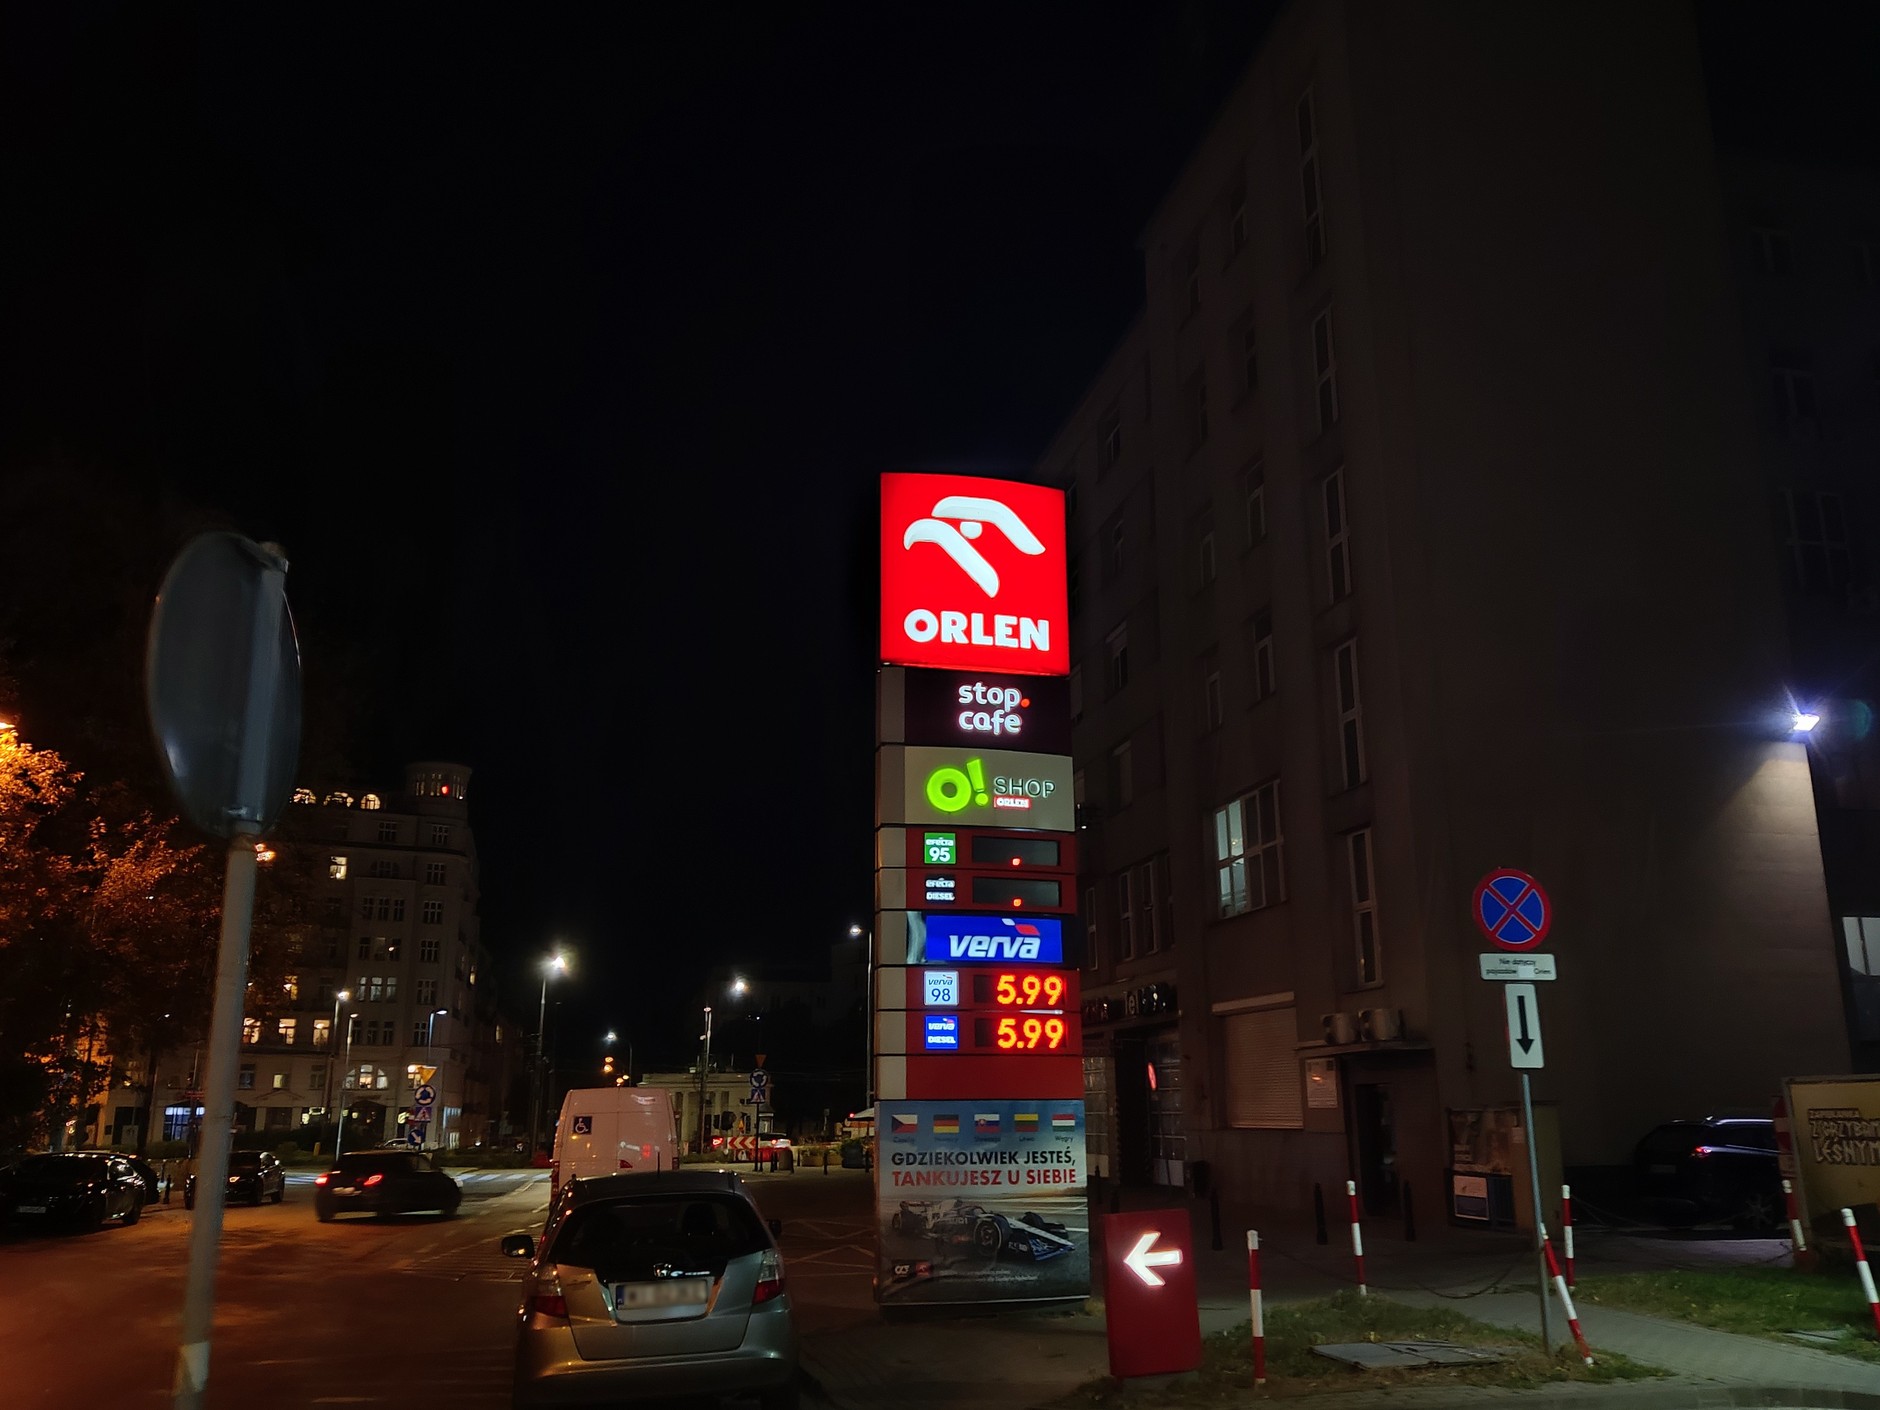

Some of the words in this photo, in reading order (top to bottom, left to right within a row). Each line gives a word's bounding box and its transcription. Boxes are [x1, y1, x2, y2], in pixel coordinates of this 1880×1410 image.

[904, 609, 1050, 651] ORLEN
[958, 710, 1022, 735] cafe
[926, 758, 989, 812] O!
[994, 776, 1055, 798] SHOP
[929, 847, 951, 862] 95
[949, 935, 1041, 959] verva
[931, 988, 951, 1002] 98
[997, 975, 1063, 1005] 5.99
[997, 1018, 1064, 1048] 5.99
[892, 1151, 1019, 1166] GDZIEKOLWIEK
[1024, 1146, 1075, 1166] JESTEŚ,
[892, 1170, 1002, 1187] TANKUJESZ
[1008, 1170, 1020, 1185] U
[1026, 1169, 1076, 1185] SIEBIE
